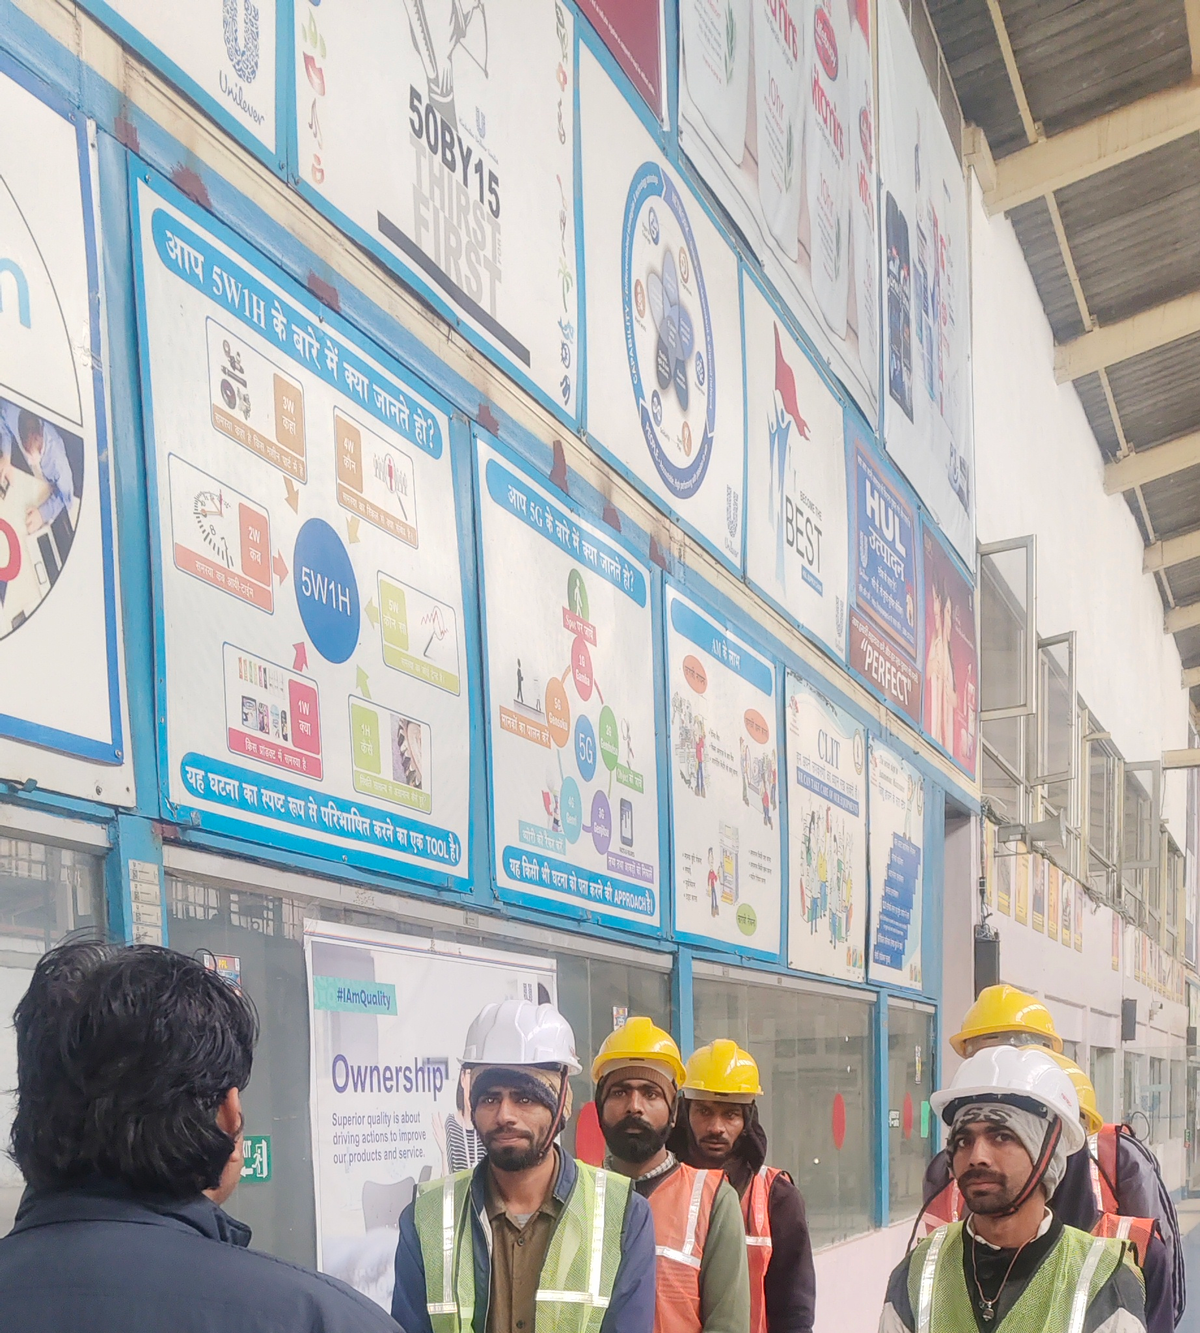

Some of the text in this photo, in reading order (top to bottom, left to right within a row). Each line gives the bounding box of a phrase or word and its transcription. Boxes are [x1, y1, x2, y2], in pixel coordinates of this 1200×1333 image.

[219, 69, 265, 125] Unilever
[409, 83, 500, 219] 50BY15
[409, 131, 501, 265] THIRST
[412, 183, 502, 318] FIRST
[165, 229, 434, 453] आप 5W1H के बारे में क्या जानते हो?
[282, 396, 294, 414] 3W
[248, 526, 260, 544] 2W
[507, 484, 527, 511] आप
[530, 502, 543, 528] 5G
[545, 506, 554, 536] के
[556, 519, 571, 549] बारे
[572, 527, 580, 554] में
[582, 540, 598, 567] क्या
[599, 554, 621, 584] जानते
[785, 495, 823, 573] BEST
[866, 479, 906, 558] HUL
[869, 525, 905, 582] उत्पादन
[301, 566, 351, 616] 5W1H
[298, 699, 310, 715] 1W
[298, 719, 311, 736] क्या
[579, 732, 594, 765] 5G
[818, 729, 840, 770] CLIT
[185, 765, 205, 793] यह
[209, 772, 240, 801] घटना
[242, 781, 258, 807] का
[261, 788, 285, 814] स्पष्ट
[288, 796, 305, 823] रूप
[307, 797, 318, 824] से
[320, 801, 370, 836] परिभाषित
[373, 815, 394, 843] करने
[396, 825, 408, 847] का
[410, 829, 424, 852] एक
[426, 834, 449, 860] TOOL
[509, 858, 521, 879] यह
[521, 854, 540, 881] किसी
[540, 861, 551, 884] भी
[551, 869, 568, 890] घटना
[589, 878, 604, 900] करने
[614, 888, 646, 914] APPROACH
[337, 987, 391, 1011] #IAmQuality
[332, 1054, 444, 1101] Ownership
[332, 1111, 420, 1129] Superior quality is about
[333, 1129, 427, 1147] driving actions to improve
[333, 1147, 425, 1167] our products and service.
